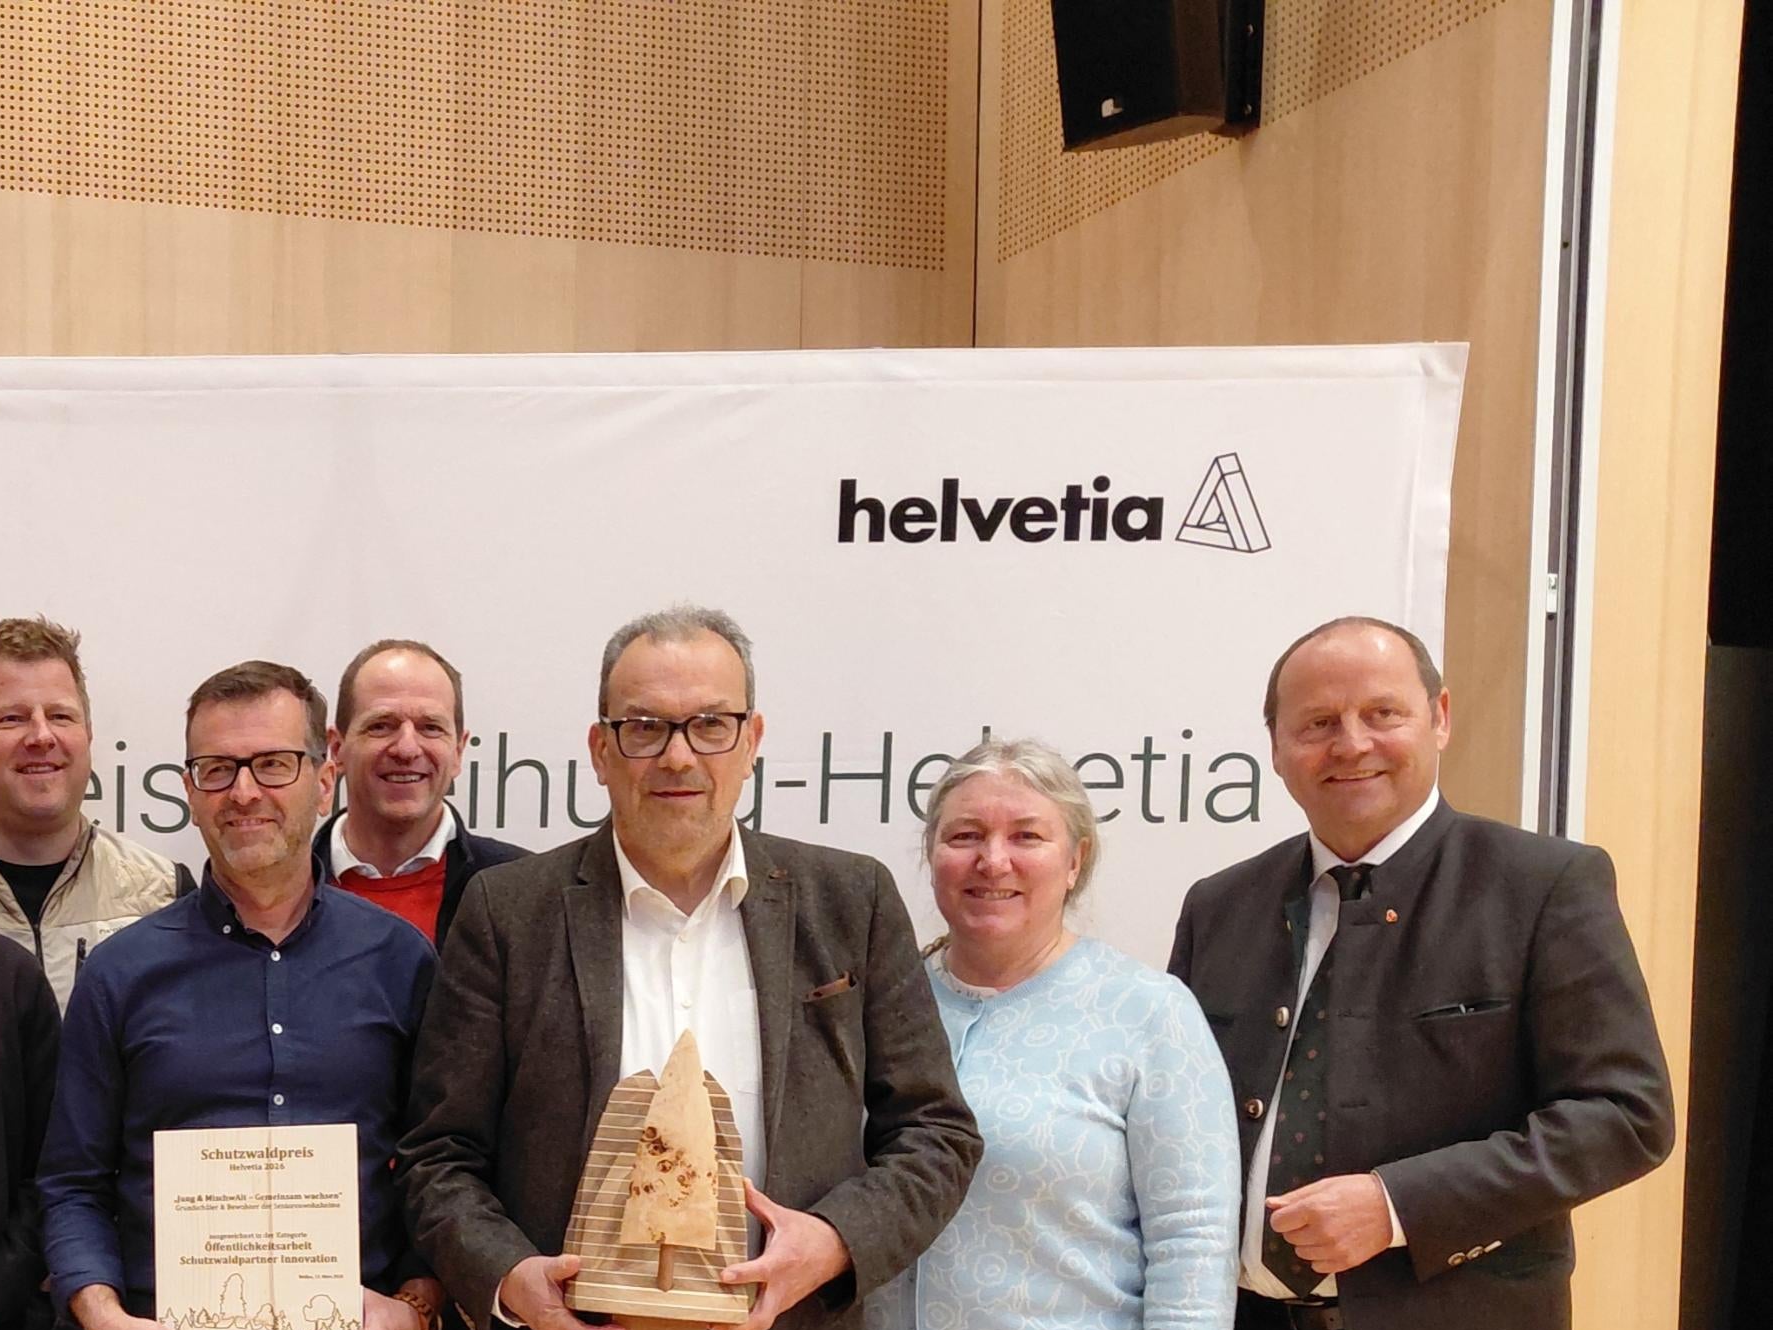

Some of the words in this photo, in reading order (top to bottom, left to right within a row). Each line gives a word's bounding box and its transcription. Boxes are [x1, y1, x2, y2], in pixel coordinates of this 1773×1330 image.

[837, 475, 1165, 543] helvetia
[200, 1146, 315, 1161] Schutzwaldpreis
[229, 1163, 262, 1171] Helvetia
[204, 1240, 312, 1252] Öffentlichkeitsarbeit
[179, 1255, 278, 1266] Schutzwaldpartner
[281, 1254, 338, 1263] Innovation
